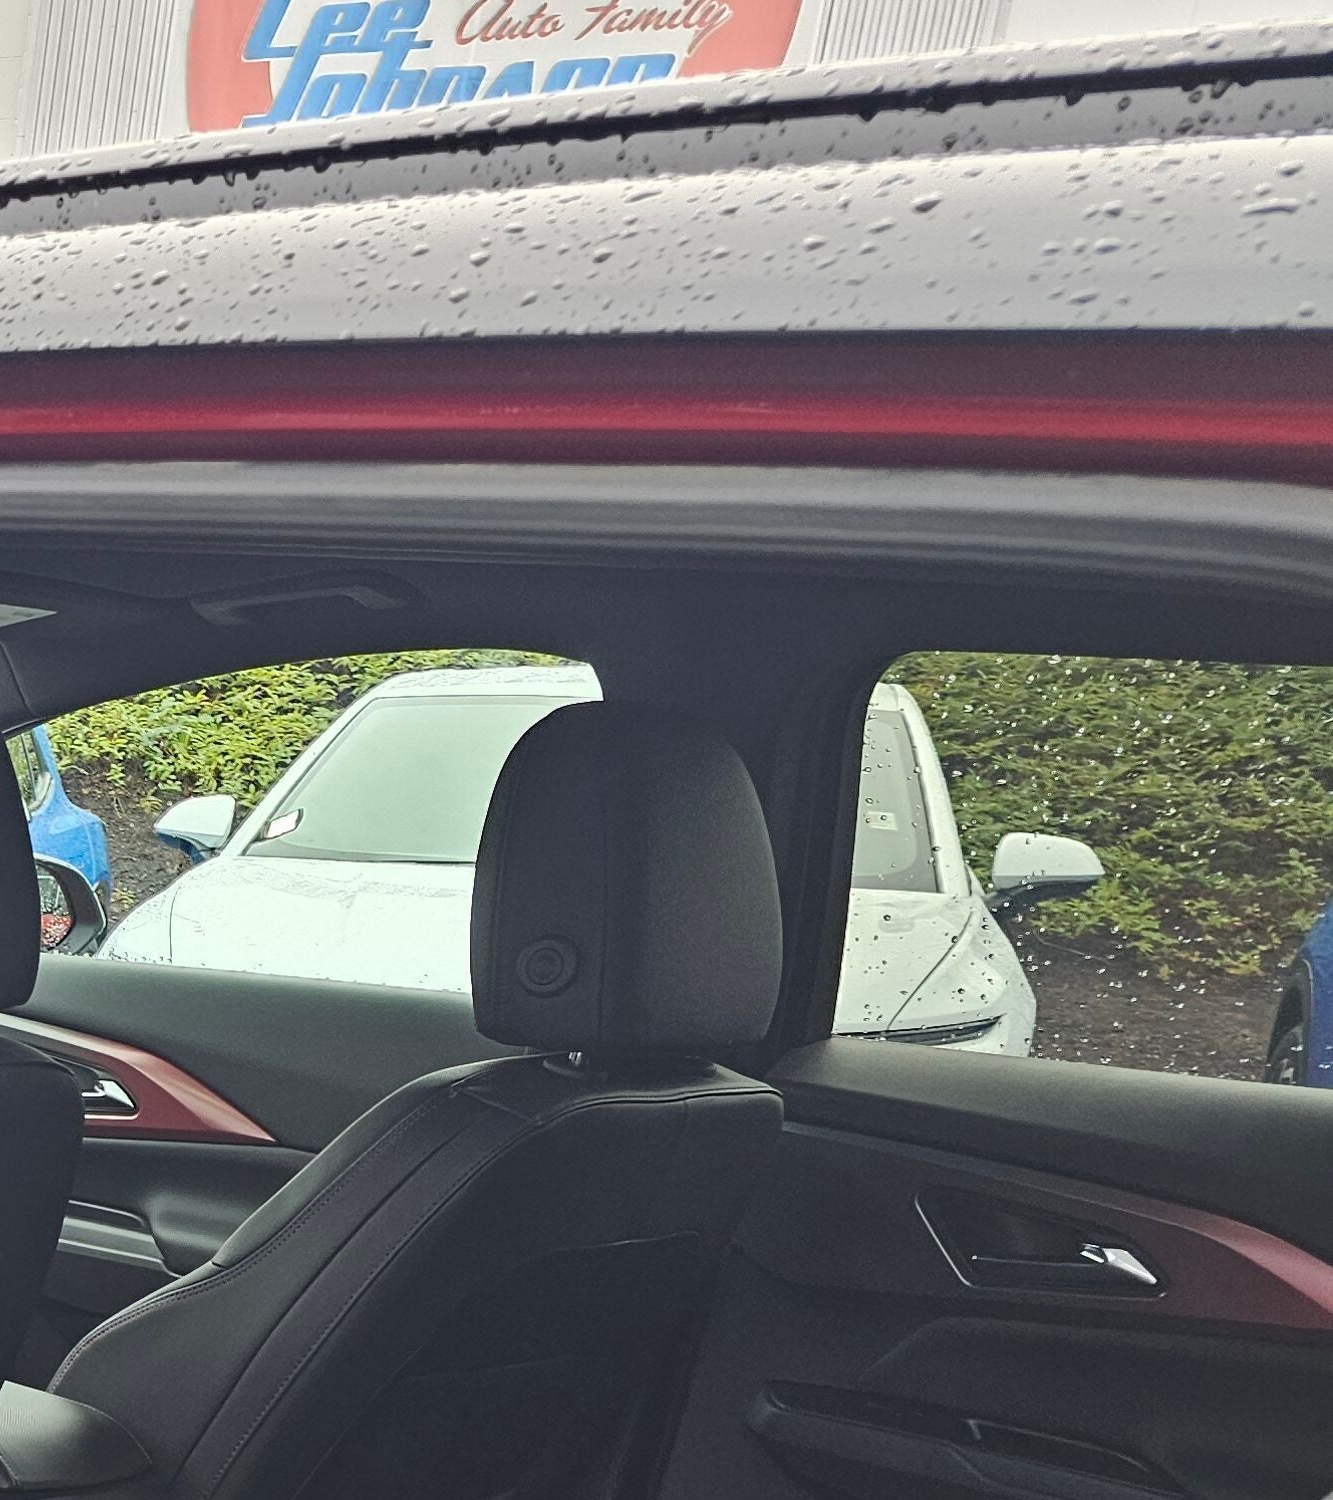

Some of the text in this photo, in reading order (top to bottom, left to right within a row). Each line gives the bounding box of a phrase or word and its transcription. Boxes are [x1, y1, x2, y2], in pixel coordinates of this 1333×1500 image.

[242, 0, 731, 60] Lee Auto Family
